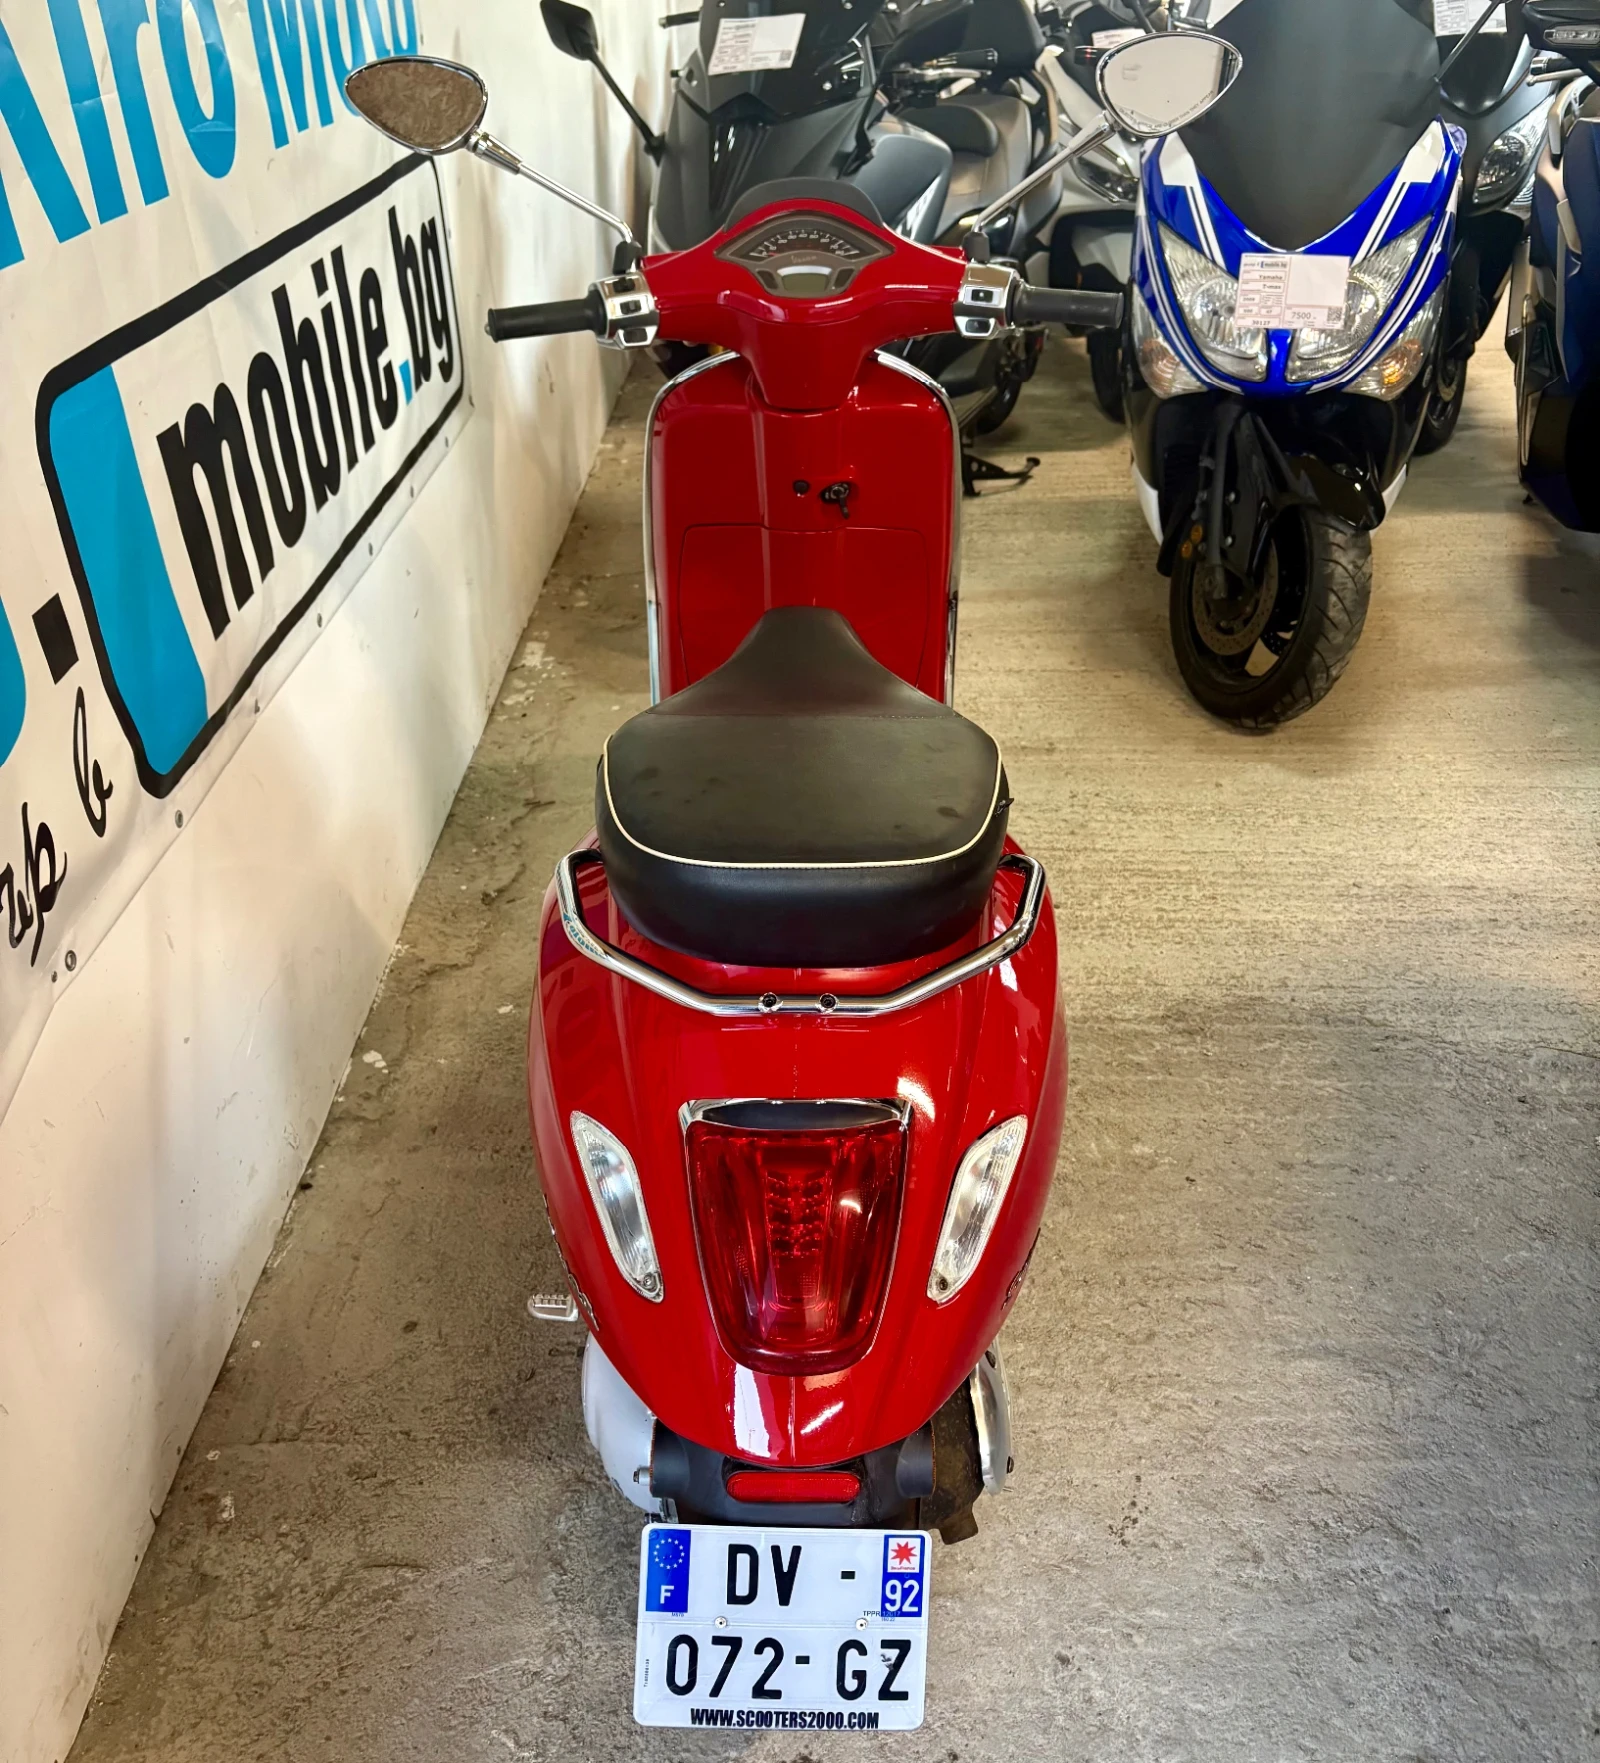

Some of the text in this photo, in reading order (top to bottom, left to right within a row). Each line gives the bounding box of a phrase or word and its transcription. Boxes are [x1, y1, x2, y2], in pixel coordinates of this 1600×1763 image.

[1291, 311, 1312, 320] 7500
[156, 204, 455, 641] mobile.bg
[726, 1543, 803, 1607] DV
[659, 1584, 675, 1605] F
[884, 1579, 920, 1613] 92
[835, 1638, 912, 1701] GZ
[690, 1707, 880, 1730] WWW.SCOOTERS2000.COM
